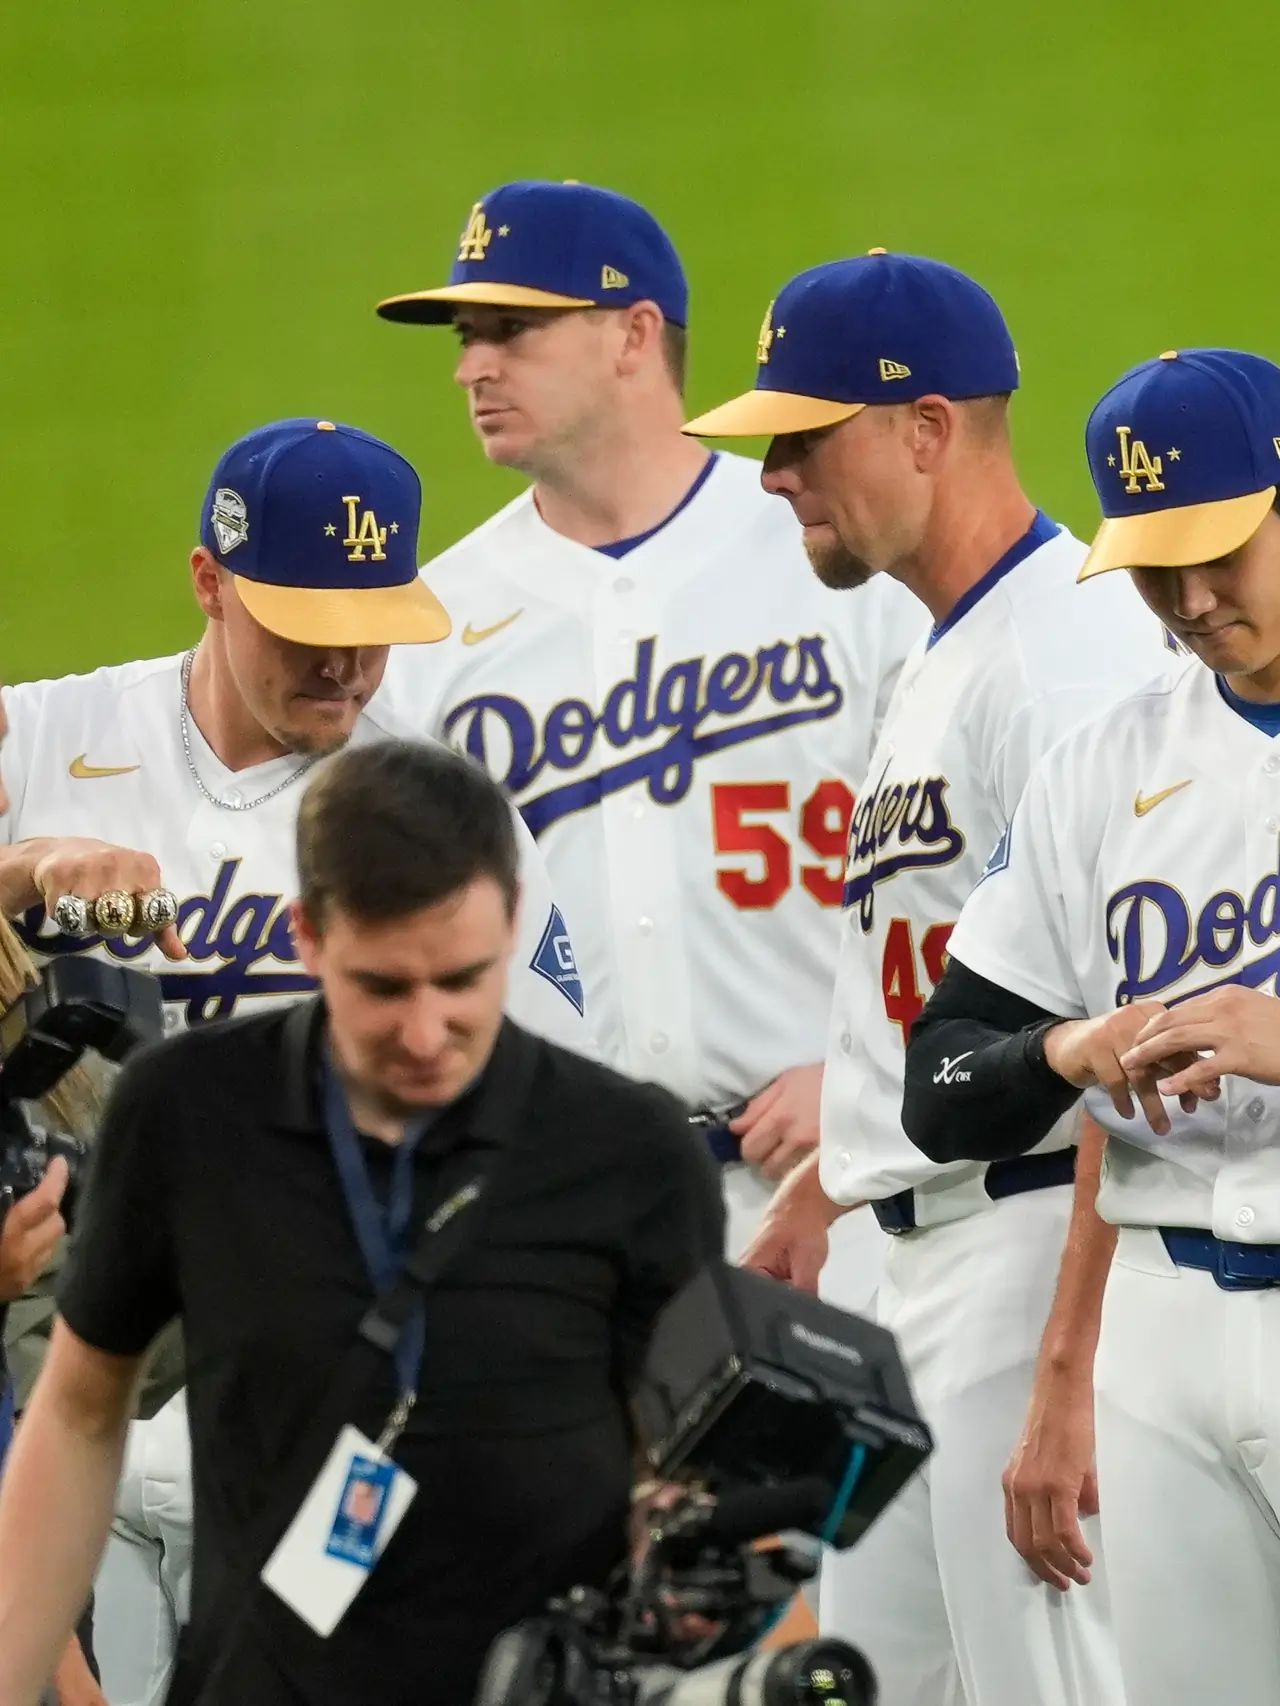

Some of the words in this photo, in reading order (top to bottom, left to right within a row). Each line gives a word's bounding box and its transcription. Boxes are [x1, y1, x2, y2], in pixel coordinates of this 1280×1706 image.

[459, 202, 491, 261] LA
[1117, 426, 1165, 494] LA
[342, 496, 387, 562] LA
[444, 635, 843, 805] Dodgers
[710, 780, 858, 912] 59
